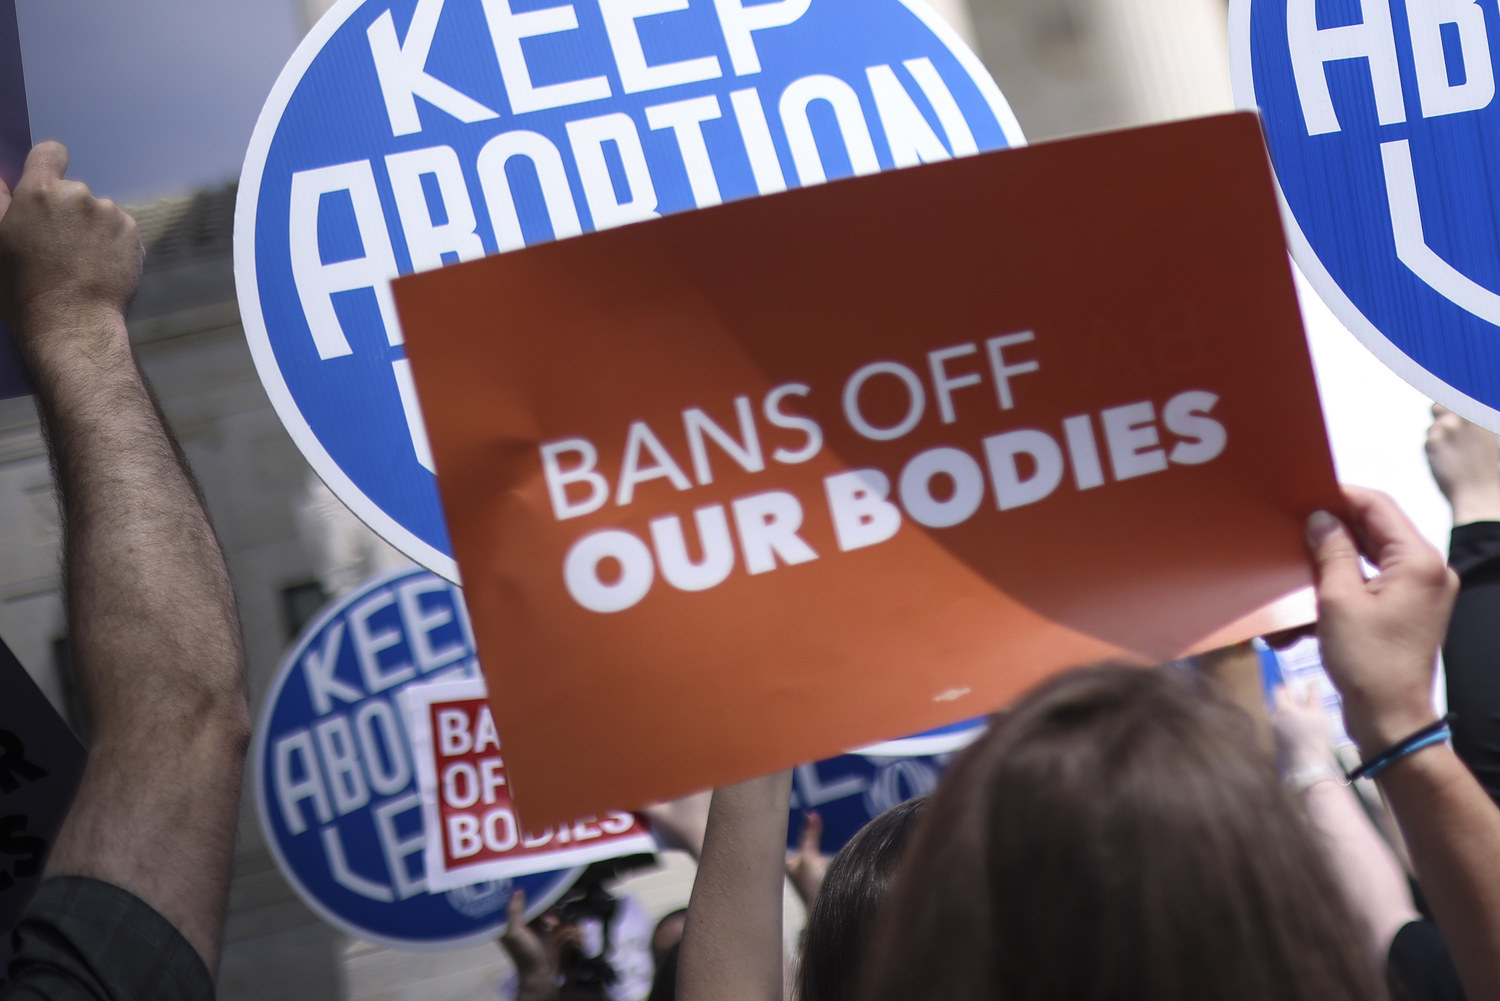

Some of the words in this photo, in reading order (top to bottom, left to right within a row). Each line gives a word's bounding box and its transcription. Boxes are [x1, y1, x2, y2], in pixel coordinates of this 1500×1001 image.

[539, 382, 824, 522] BANS
[842, 330, 1040, 441] OFF
[564, 489, 818, 614] OUR
[824, 390, 1228, 552] BODIES
[305, 574, 475, 715] KEE
[438, 705, 501, 757] BA
[443, 759, 507, 810] OF
